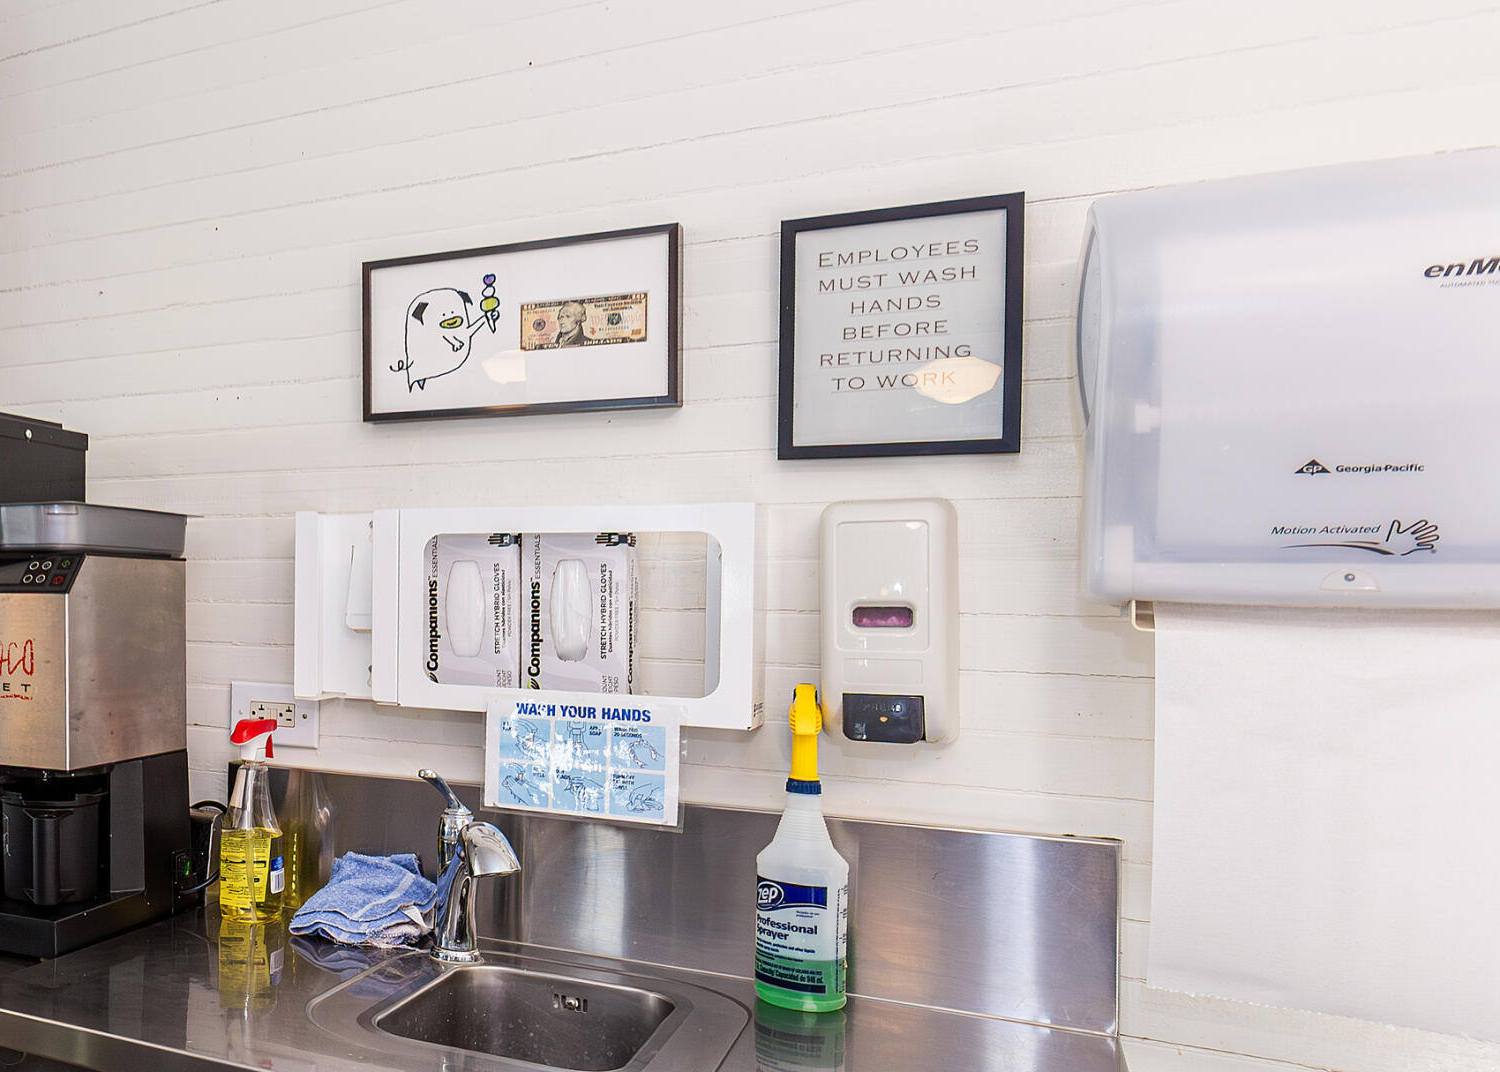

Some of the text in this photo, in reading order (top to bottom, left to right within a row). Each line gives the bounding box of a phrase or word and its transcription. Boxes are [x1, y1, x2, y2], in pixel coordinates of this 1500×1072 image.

[819, 239, 980, 268] EMPLOYEES
[1424, 255, 1500, 278] enM
[819, 265, 977, 293] MUST WASH
[850, 294, 942, 315] HANDS
[842, 319, 949, 341] BEFORE
[820, 344, 972, 368] RETURNING
[832, 370, 956, 391] TO WORK
[1335, 463, 1425, 474] Georgia-Pacific
[1271, 524, 1381, 535] Motion Activated
[427, 578, 441, 672] Companions
[528, 580, 543, 678] Companions
[516, 703, 652, 722] WASH YOUR HANDS
[757, 913, 818, 935] Professional
[757, 924, 789, 941] Sprayer
